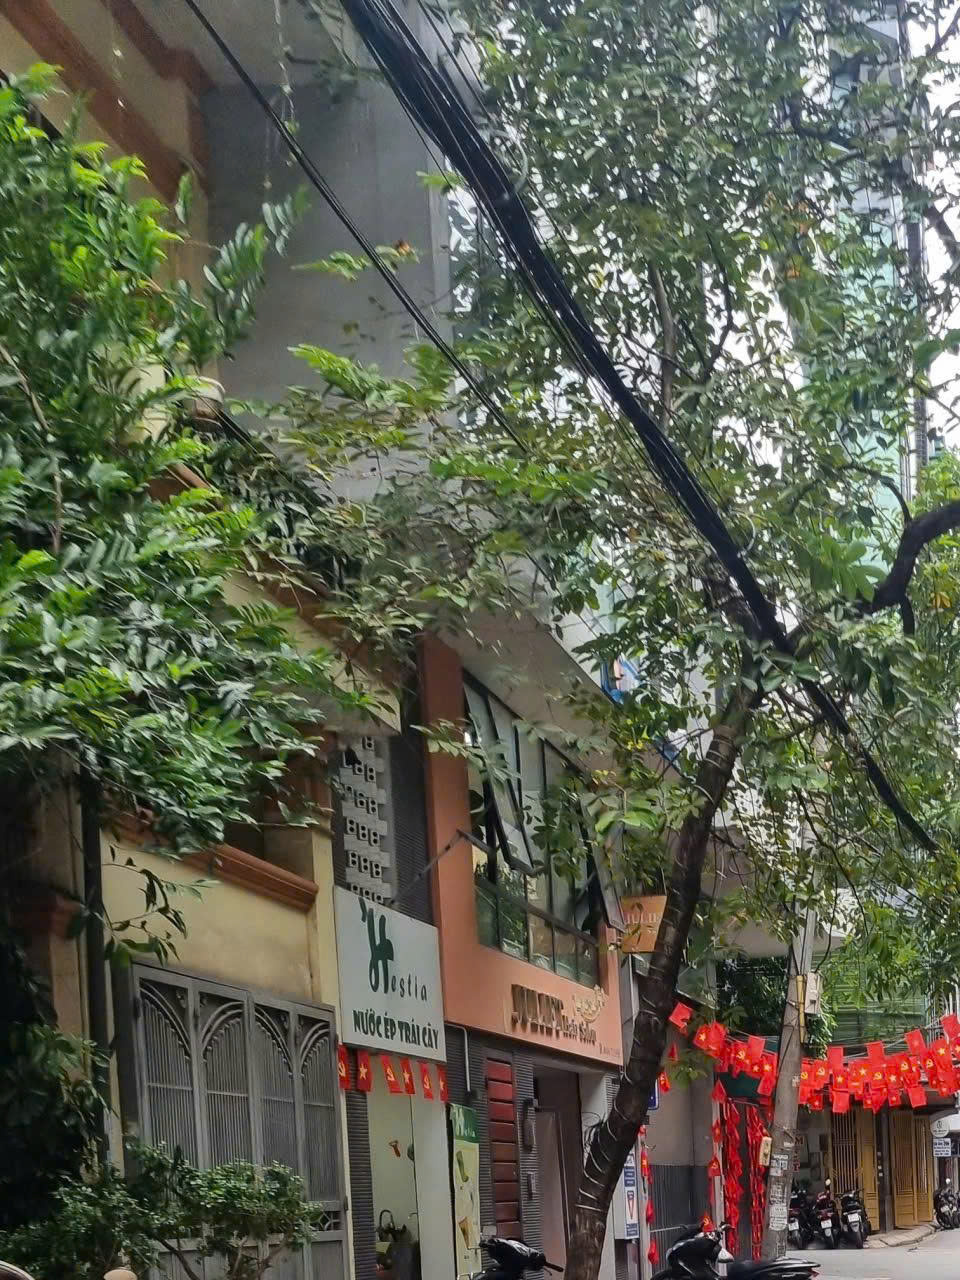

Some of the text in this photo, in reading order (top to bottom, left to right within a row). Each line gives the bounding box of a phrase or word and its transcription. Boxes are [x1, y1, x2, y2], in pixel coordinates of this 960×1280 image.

[353, 1008, 439, 1050] NƯỚC ÉP TRÁI CÂY
